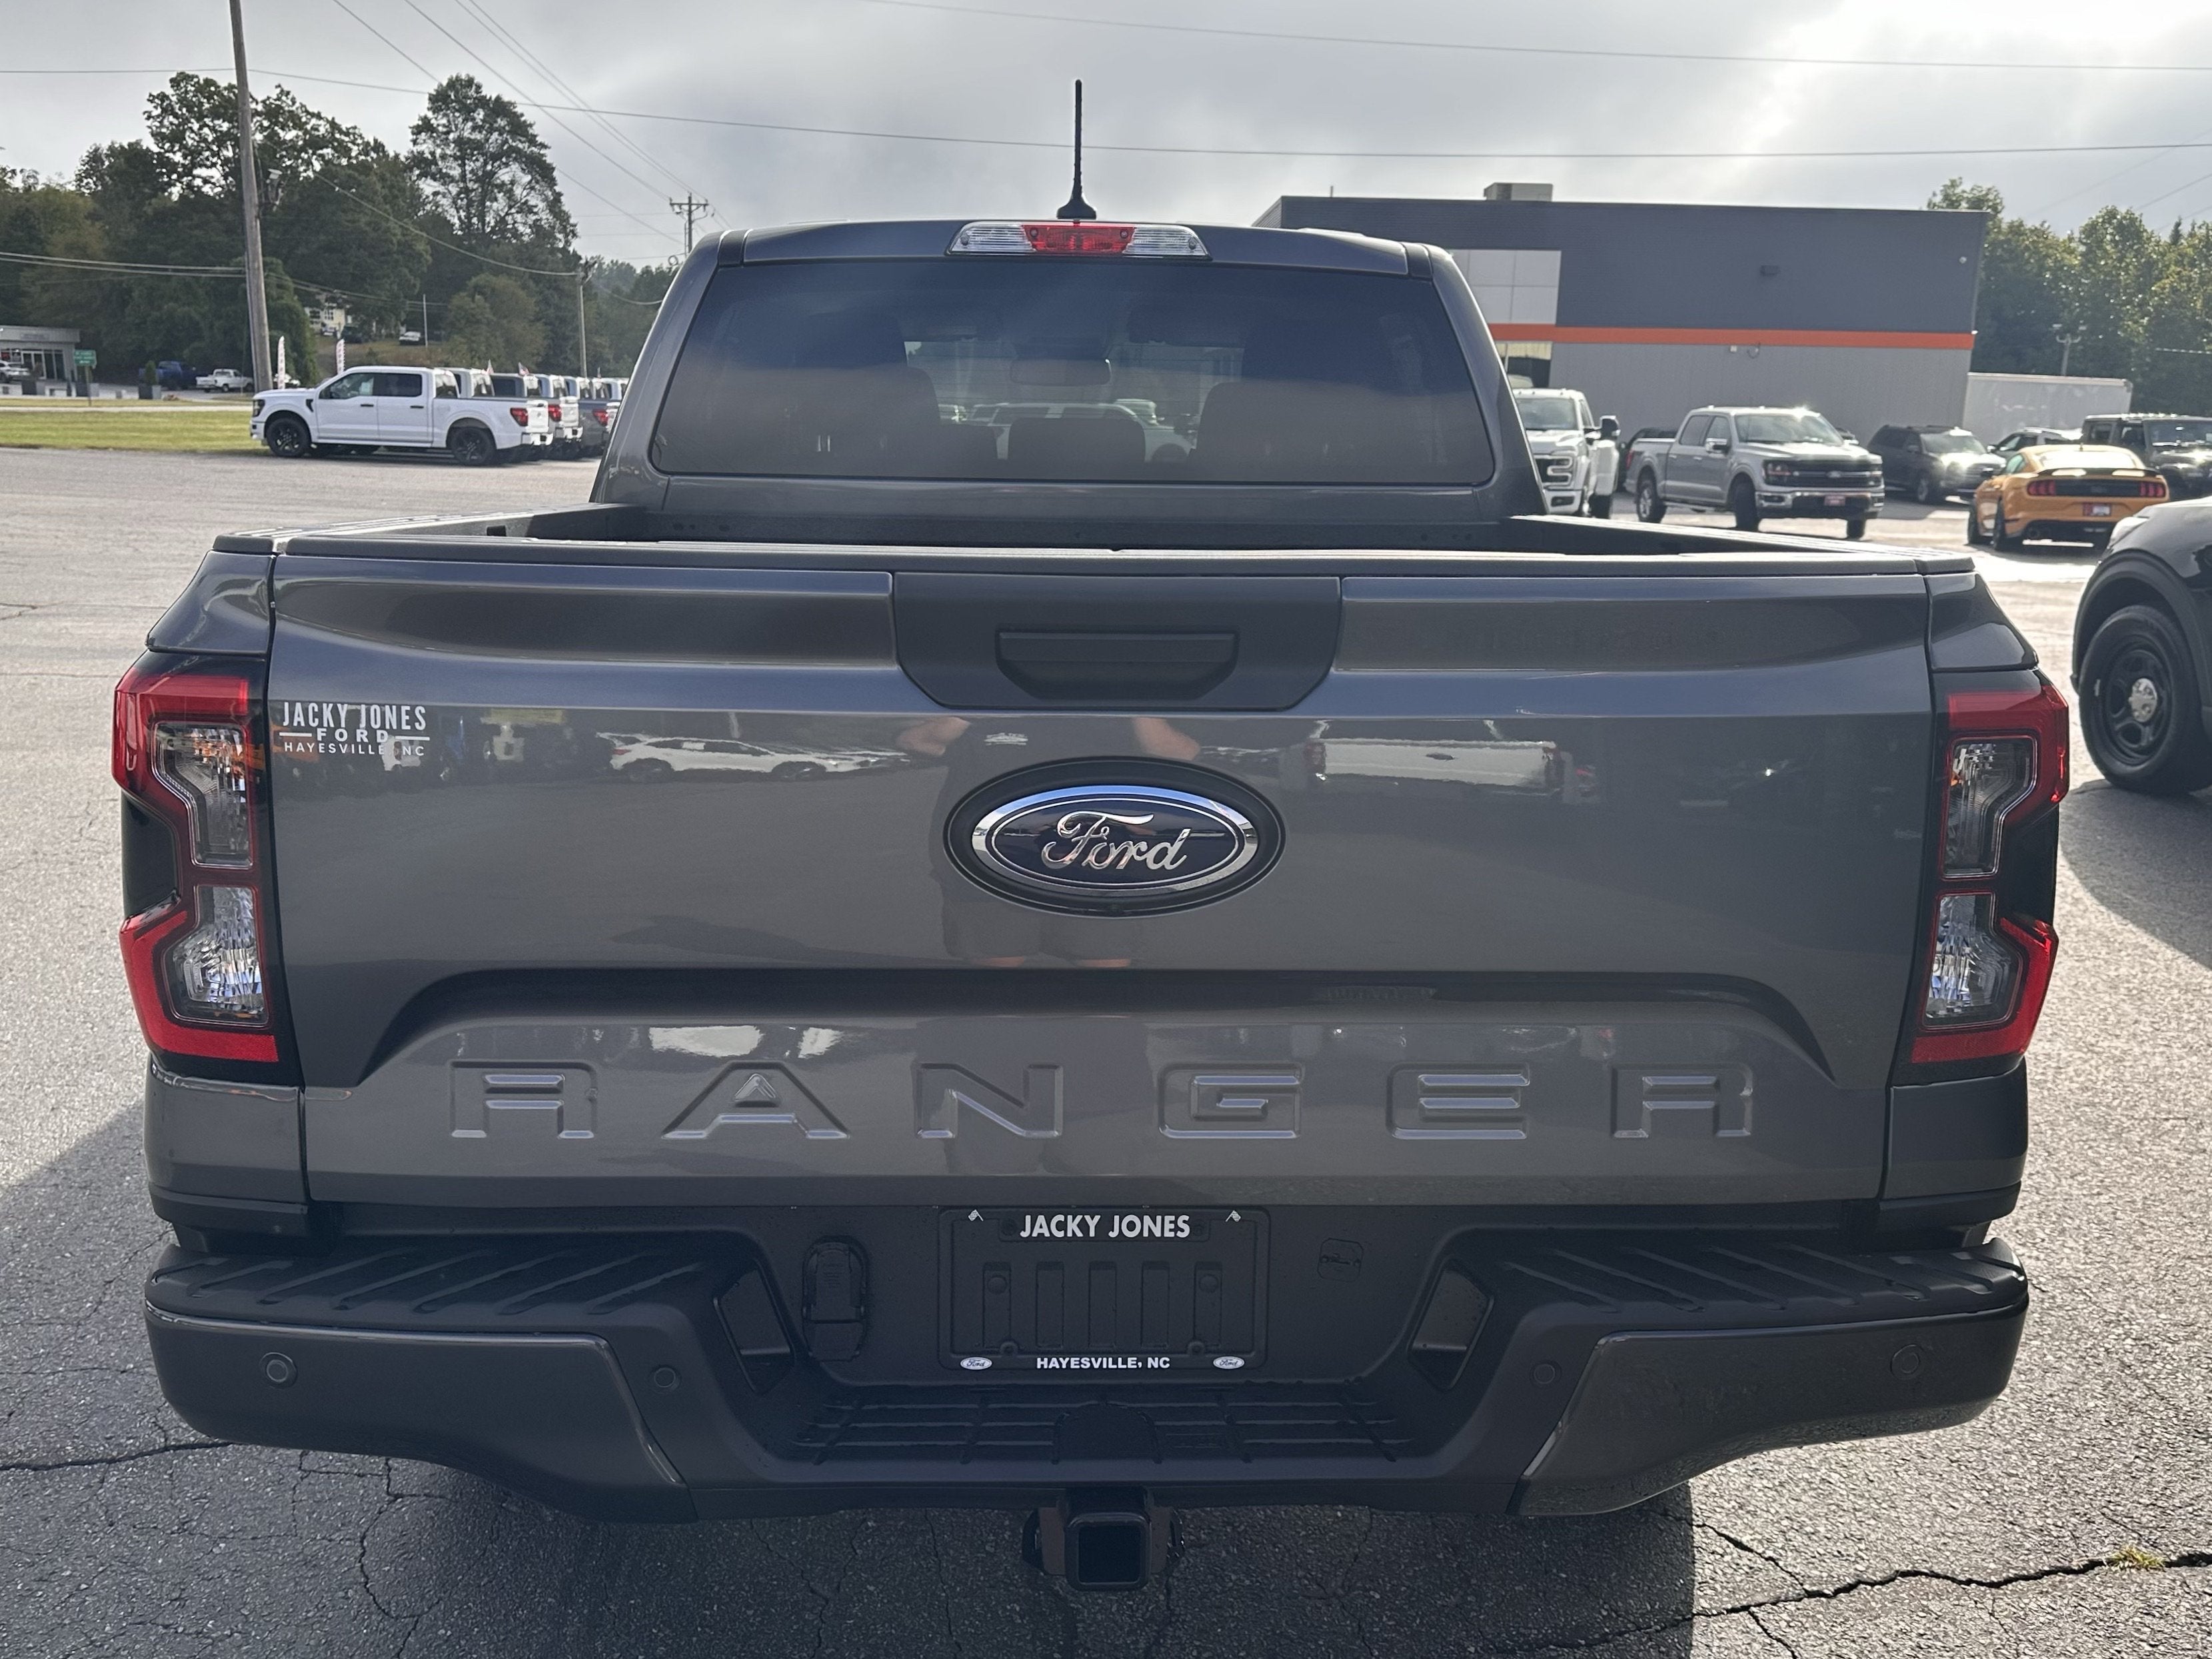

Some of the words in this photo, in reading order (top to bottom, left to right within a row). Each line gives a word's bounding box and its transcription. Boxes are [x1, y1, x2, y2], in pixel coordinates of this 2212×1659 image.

[283, 702, 348, 728] JACKY
[359, 704, 427, 731] JONES
[317, 728, 389, 743] FORD
[403, 745, 425, 757] NC
[1041, 810, 1192, 870] Ford
[448, 1060, 1753, 1140] RANGER
[1020, 1214, 1101, 1238] JACKY
[1108, 1214, 1191, 1238] JONES
[1036, 1357, 1142, 1369] HAYESVILLE,
[1147, 1357, 1170, 1368] NC
